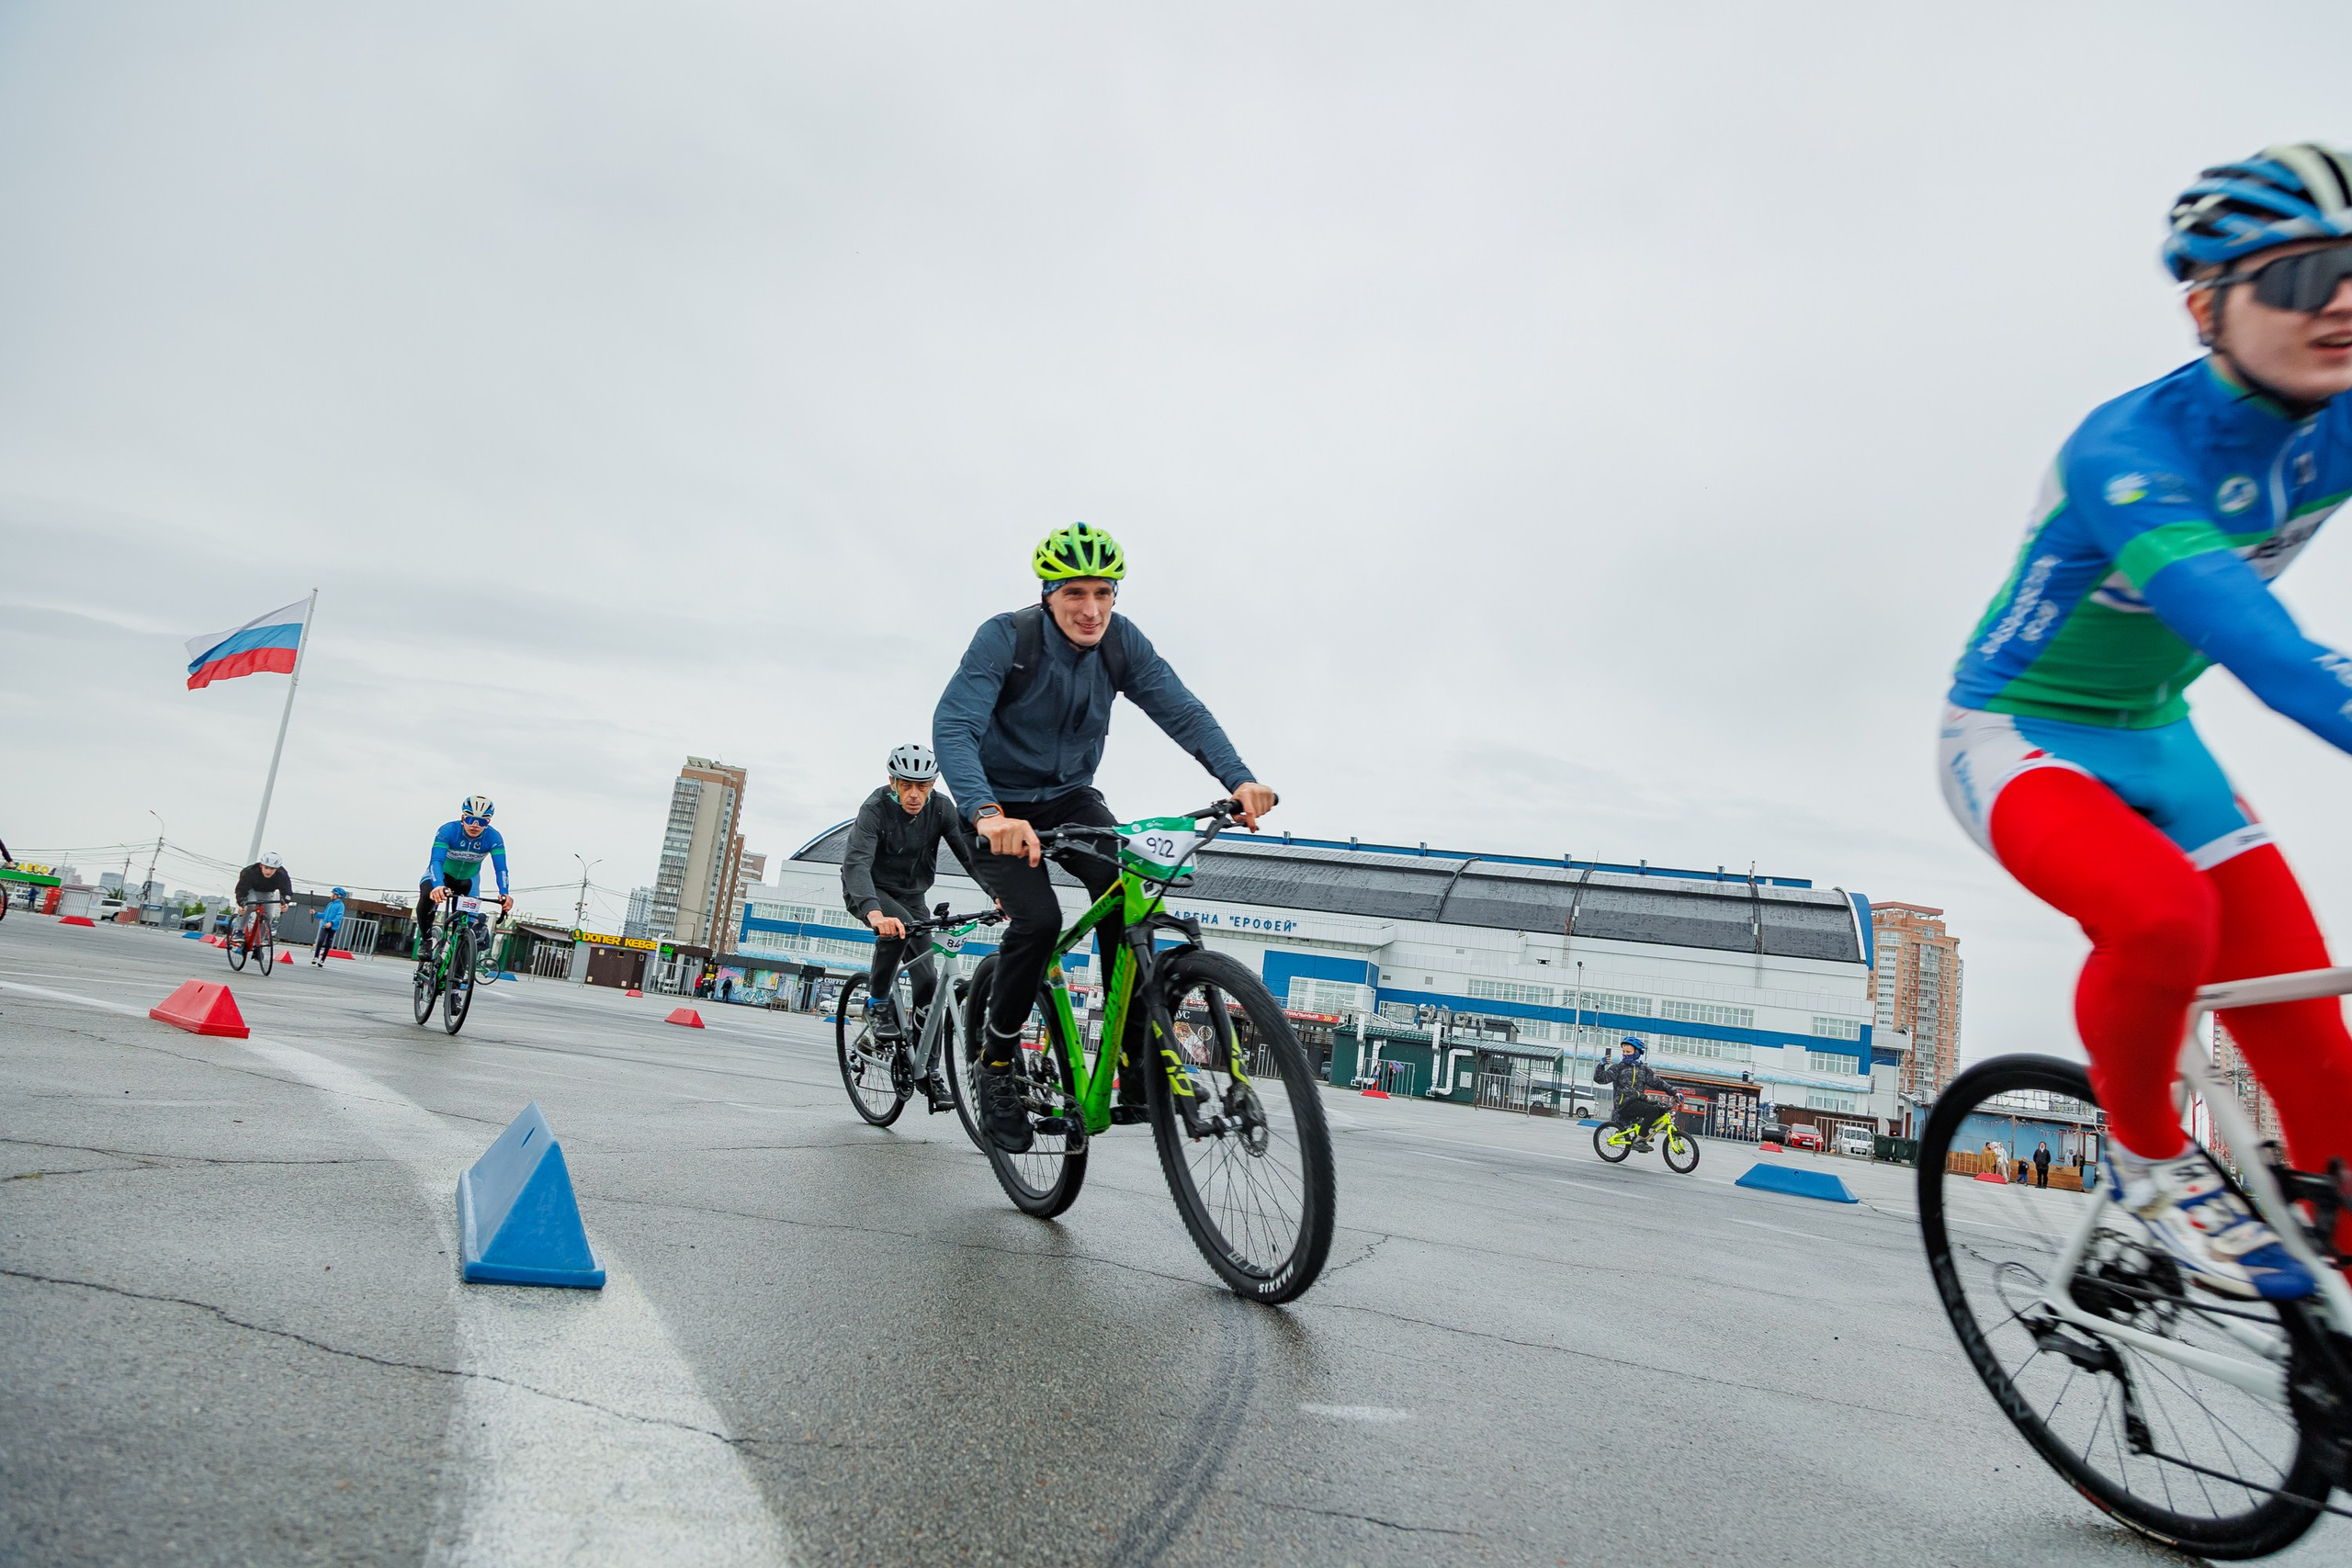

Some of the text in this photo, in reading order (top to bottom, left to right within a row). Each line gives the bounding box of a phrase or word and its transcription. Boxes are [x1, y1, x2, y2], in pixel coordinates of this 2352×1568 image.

[461, 901, 477, 909] 39
[1229, 915, 1297, 932] "ЕРОФЕЙ"
[1258, 1259, 1295, 1293] MAXXIS
